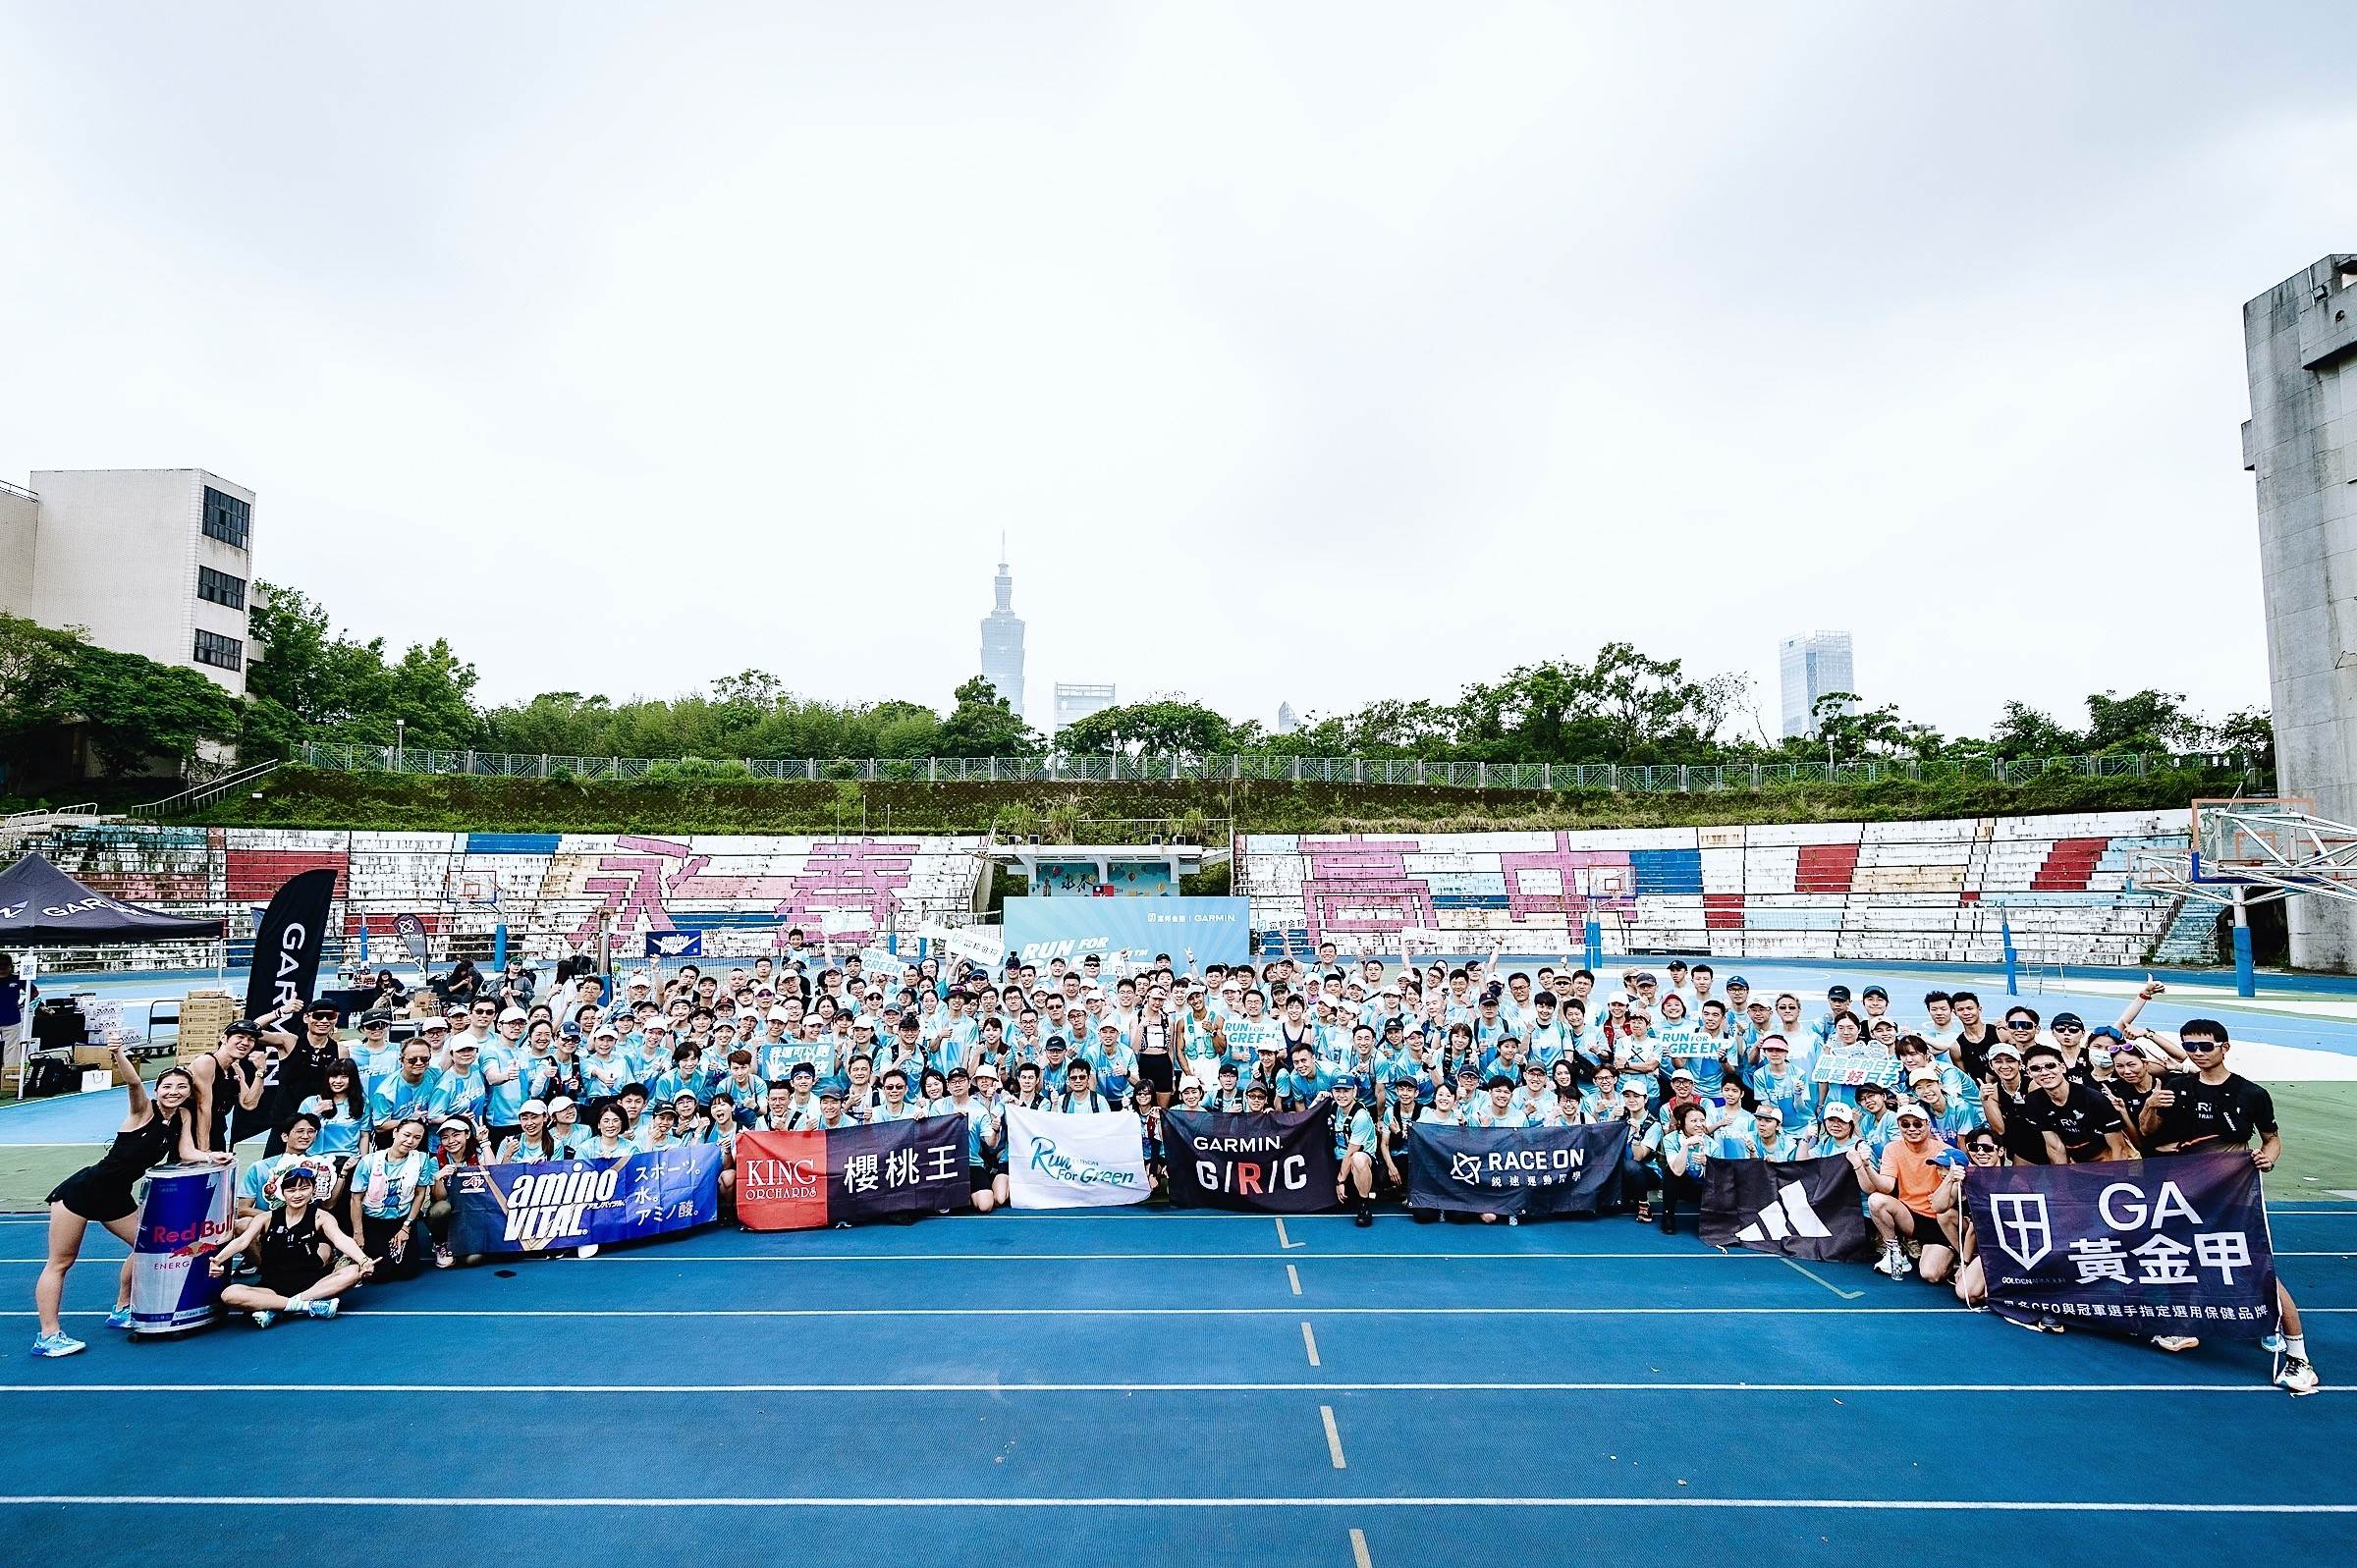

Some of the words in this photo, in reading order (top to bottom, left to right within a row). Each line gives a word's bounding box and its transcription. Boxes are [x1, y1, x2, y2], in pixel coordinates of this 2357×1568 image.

[862, 949, 883, 960] RUN
[1021, 940, 1075, 959] RUN
[1077, 937, 1109, 949] FOR
[863, 958, 903, 974] GREEN
[1225, 1022, 1248, 1032] RUN
[1229, 1033, 1276, 1044] GREE
[1662, 1033, 1689, 1042] RUN
[1669, 1043, 1722, 1054] GREEN
[1193, 1136, 1281, 1153] GARMIN
[1031, 1136, 1071, 1179] Run
[1488, 1151, 1548, 1171] RACE
[1553, 1149, 1584, 1169] ON
[745, 1159, 817, 1187] KING
[843, 1144, 959, 1194] 櫻桃王
[1057, 1168, 1077, 1182] For
[1080, 1167, 1134, 1185] Green
[507, 1162, 618, 1210] amino
[745, 1186, 817, 1200] ORCHARDS
[2098, 1181, 2204, 1231] GA
[153, 1222, 195, 1243] Red
[200, 1214, 234, 1238] Bull
